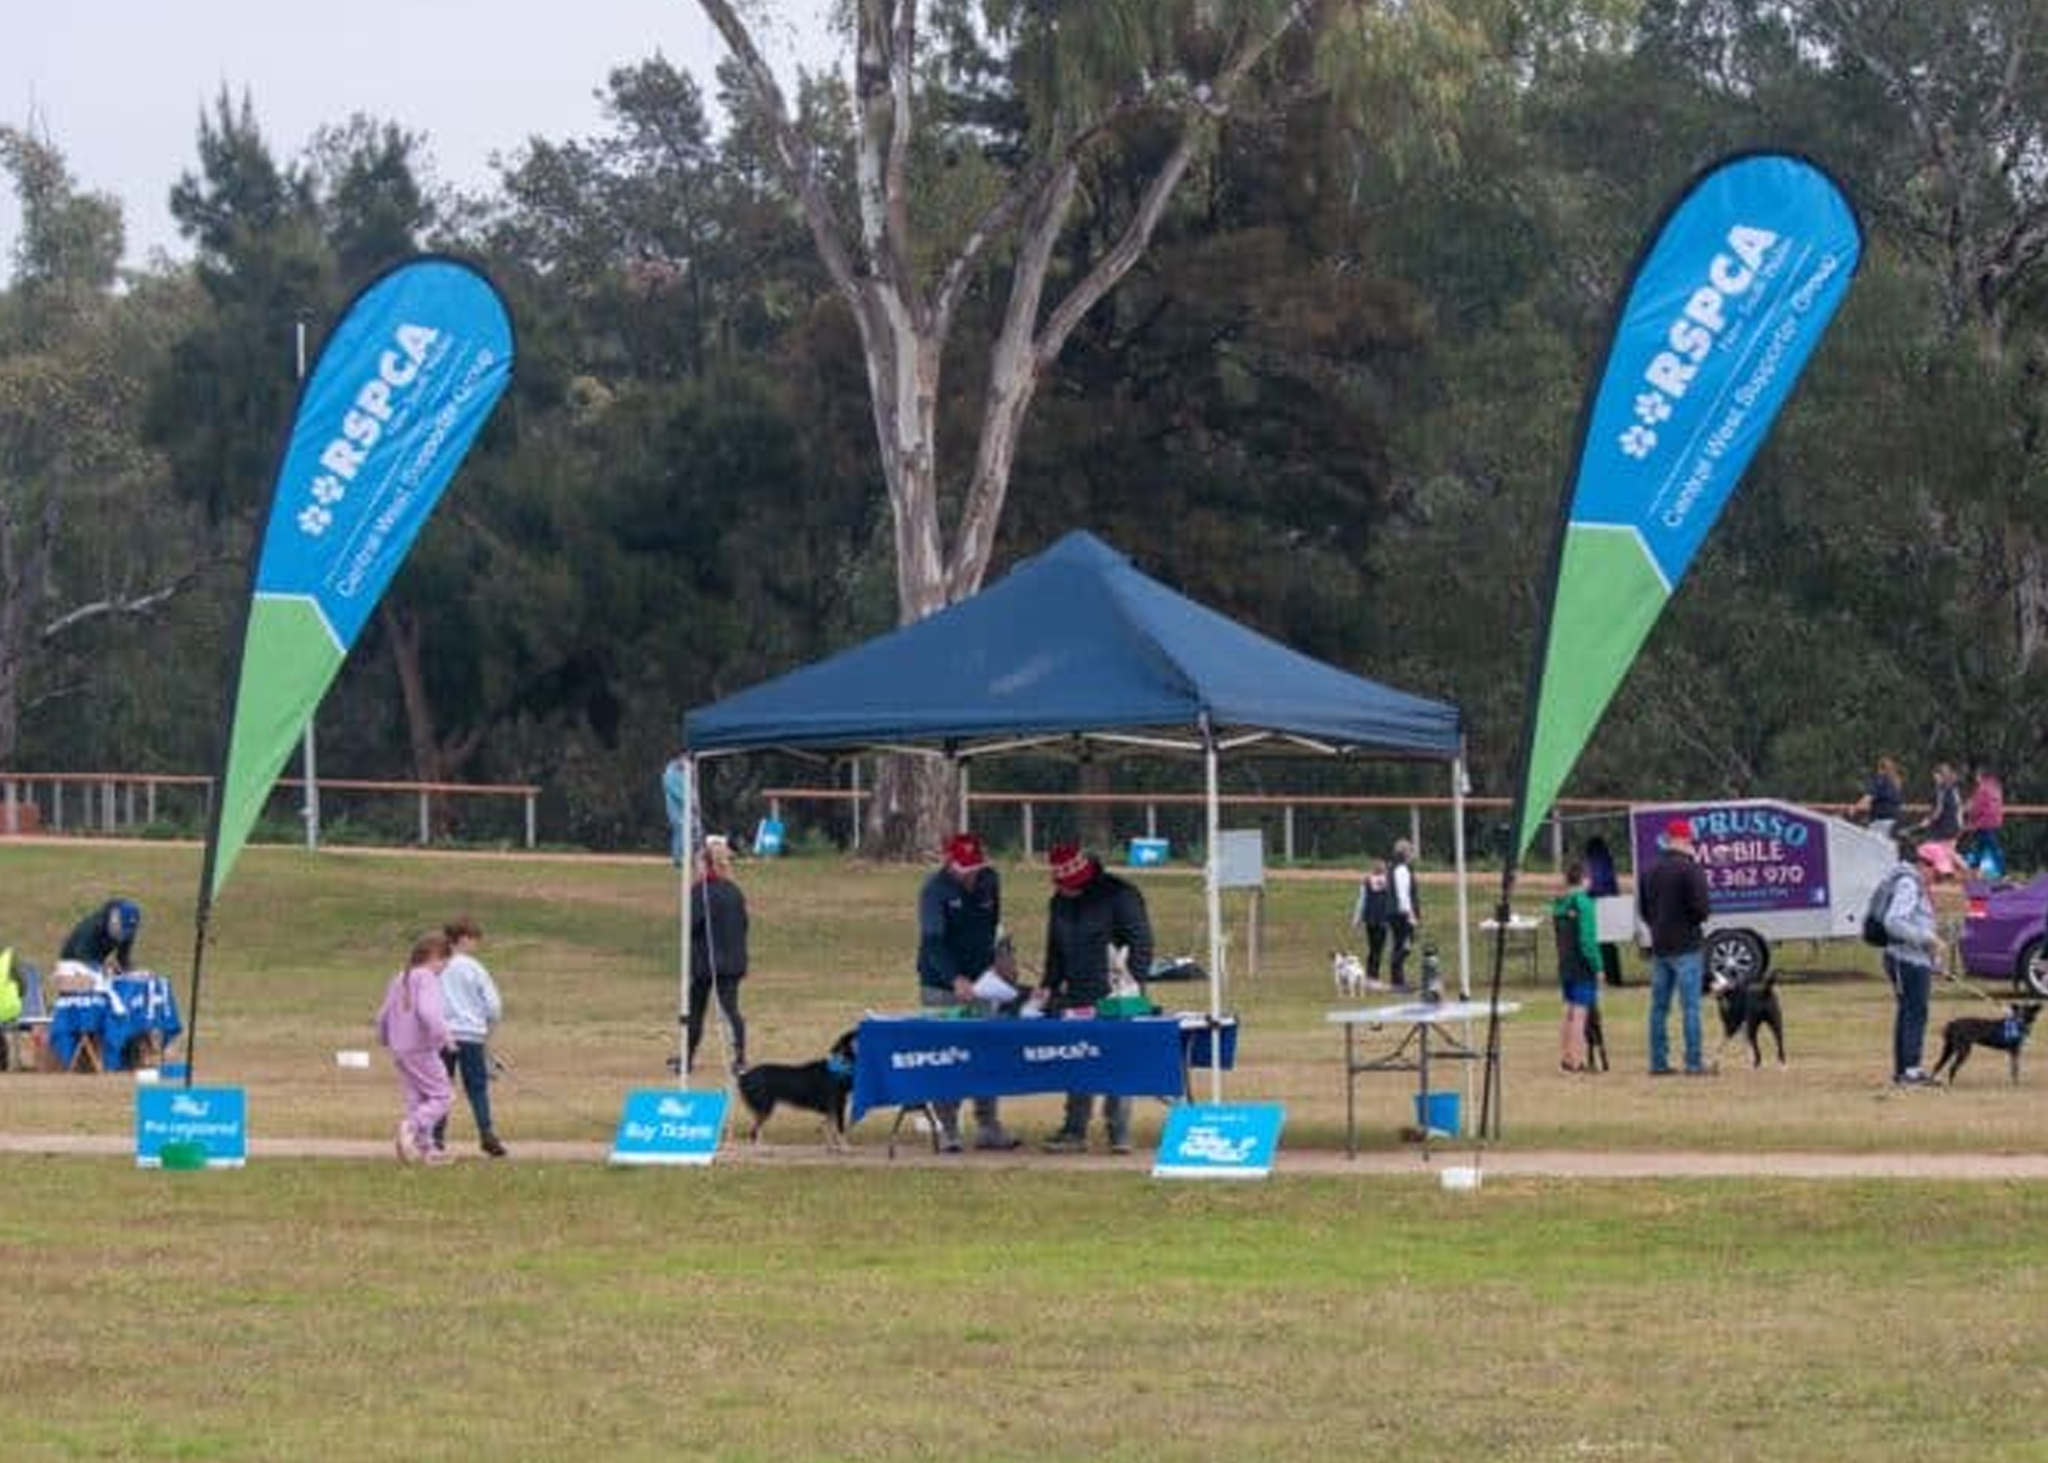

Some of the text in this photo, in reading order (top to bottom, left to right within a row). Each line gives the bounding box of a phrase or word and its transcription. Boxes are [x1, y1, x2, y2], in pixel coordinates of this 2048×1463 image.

[1646, 225, 1777, 396] RSPCA
[320, 323, 439, 480] RSPCA
[1661, 460, 1713, 527] Central
[1703, 407, 1744, 457] West
[1732, 314, 1799, 404] Supporter
[336, 533, 382, 597] Central
[376, 488, 411, 532] West
